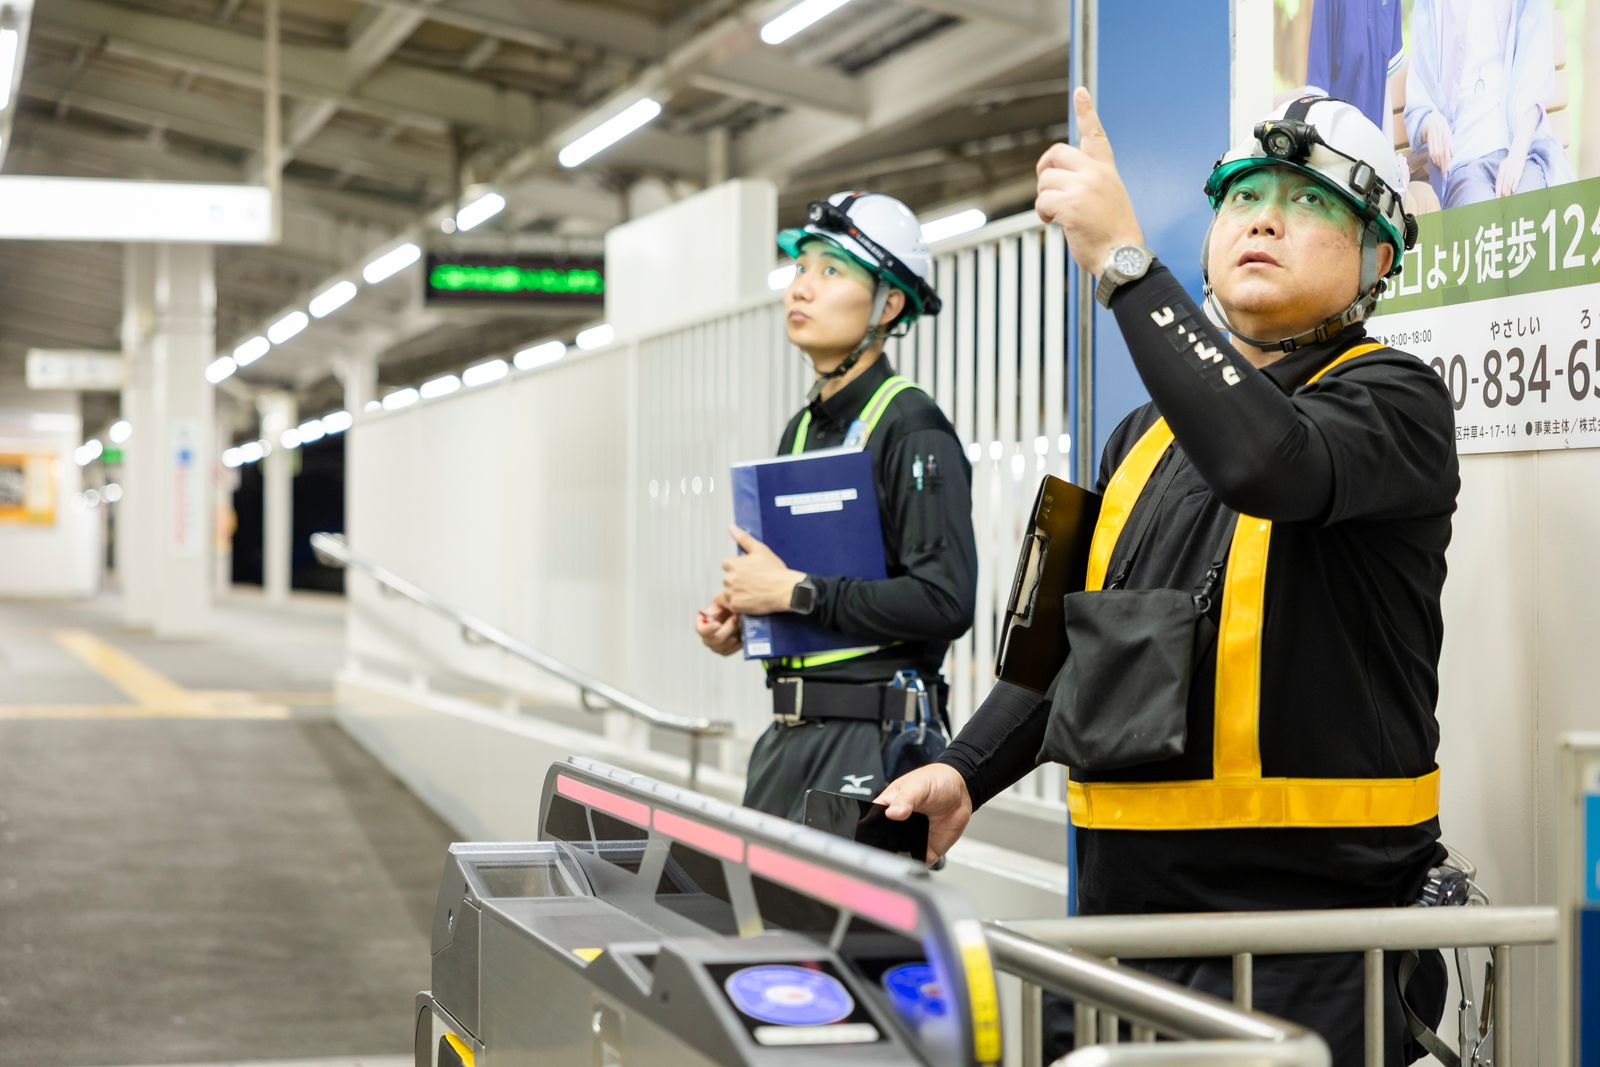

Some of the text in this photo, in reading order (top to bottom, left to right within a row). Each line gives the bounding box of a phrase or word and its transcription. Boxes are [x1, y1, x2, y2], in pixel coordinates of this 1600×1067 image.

[1390, 329, 1432, 346] 9:00-18:00
[1490, 316, 1541, 340] やさしい
